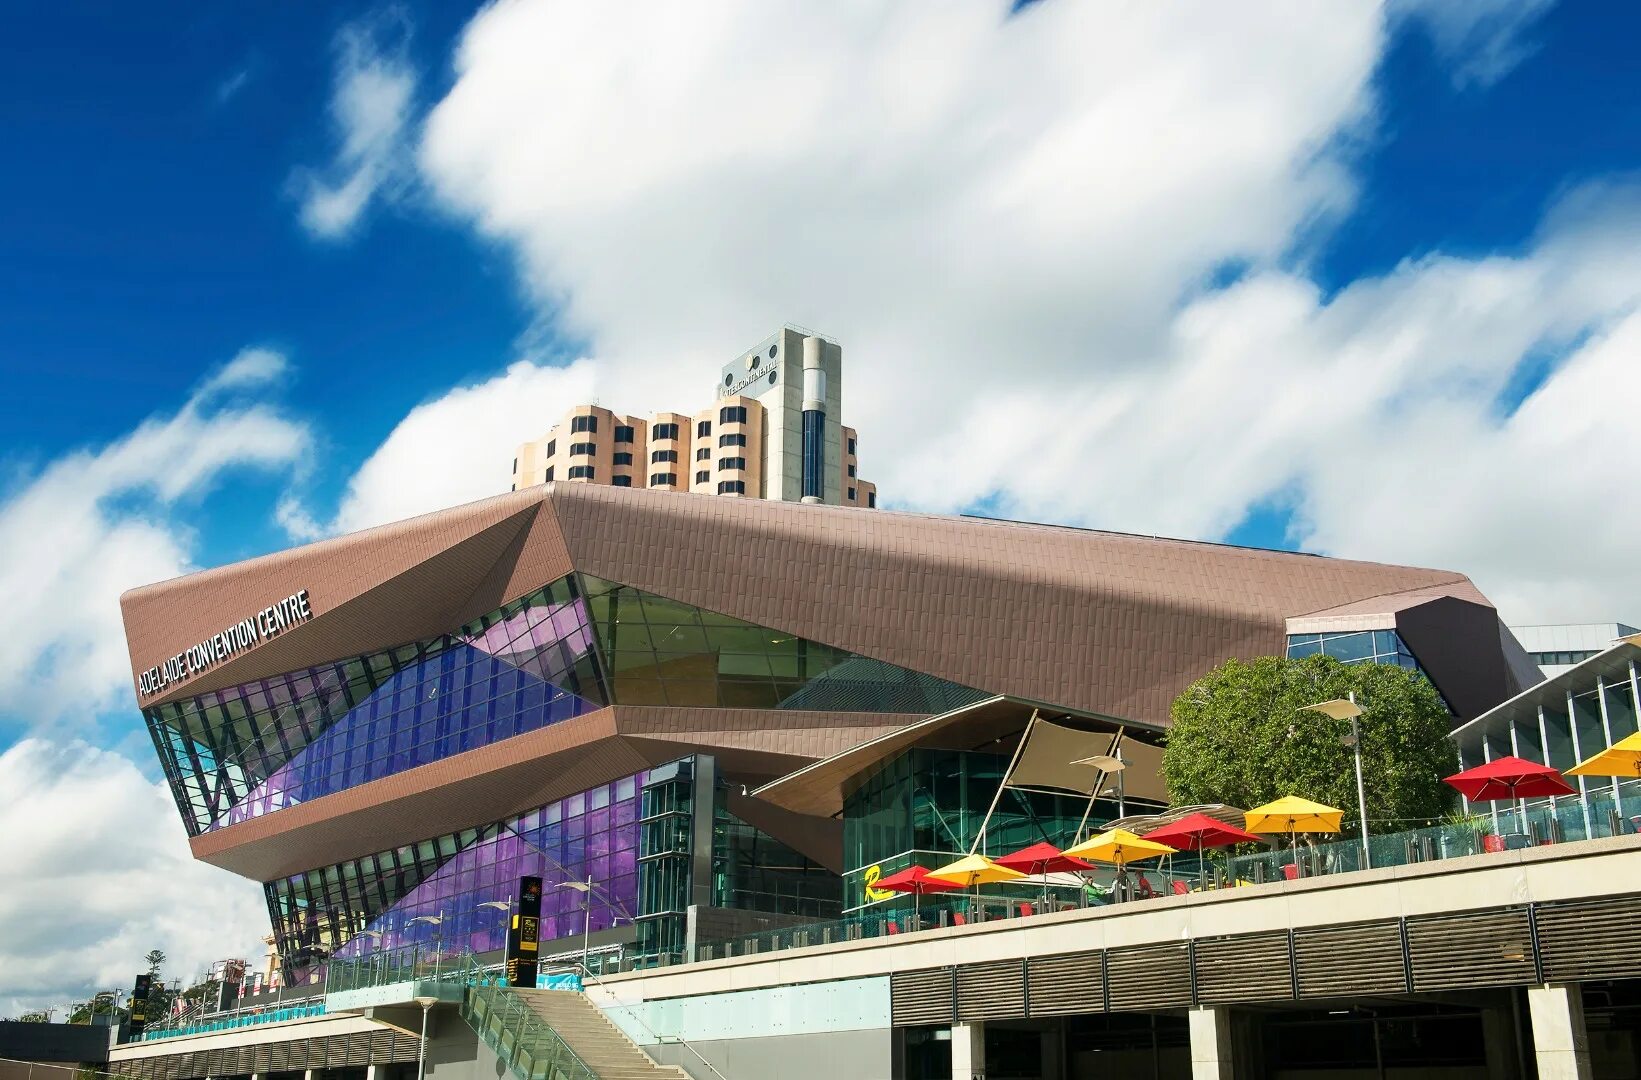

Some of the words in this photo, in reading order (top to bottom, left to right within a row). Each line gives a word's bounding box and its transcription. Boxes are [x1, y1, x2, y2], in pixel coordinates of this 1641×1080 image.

[139, 655, 187, 697] ADELAIDE
[186, 616, 258, 672] CONVENTION
[258, 589, 311, 637] CENTRE
